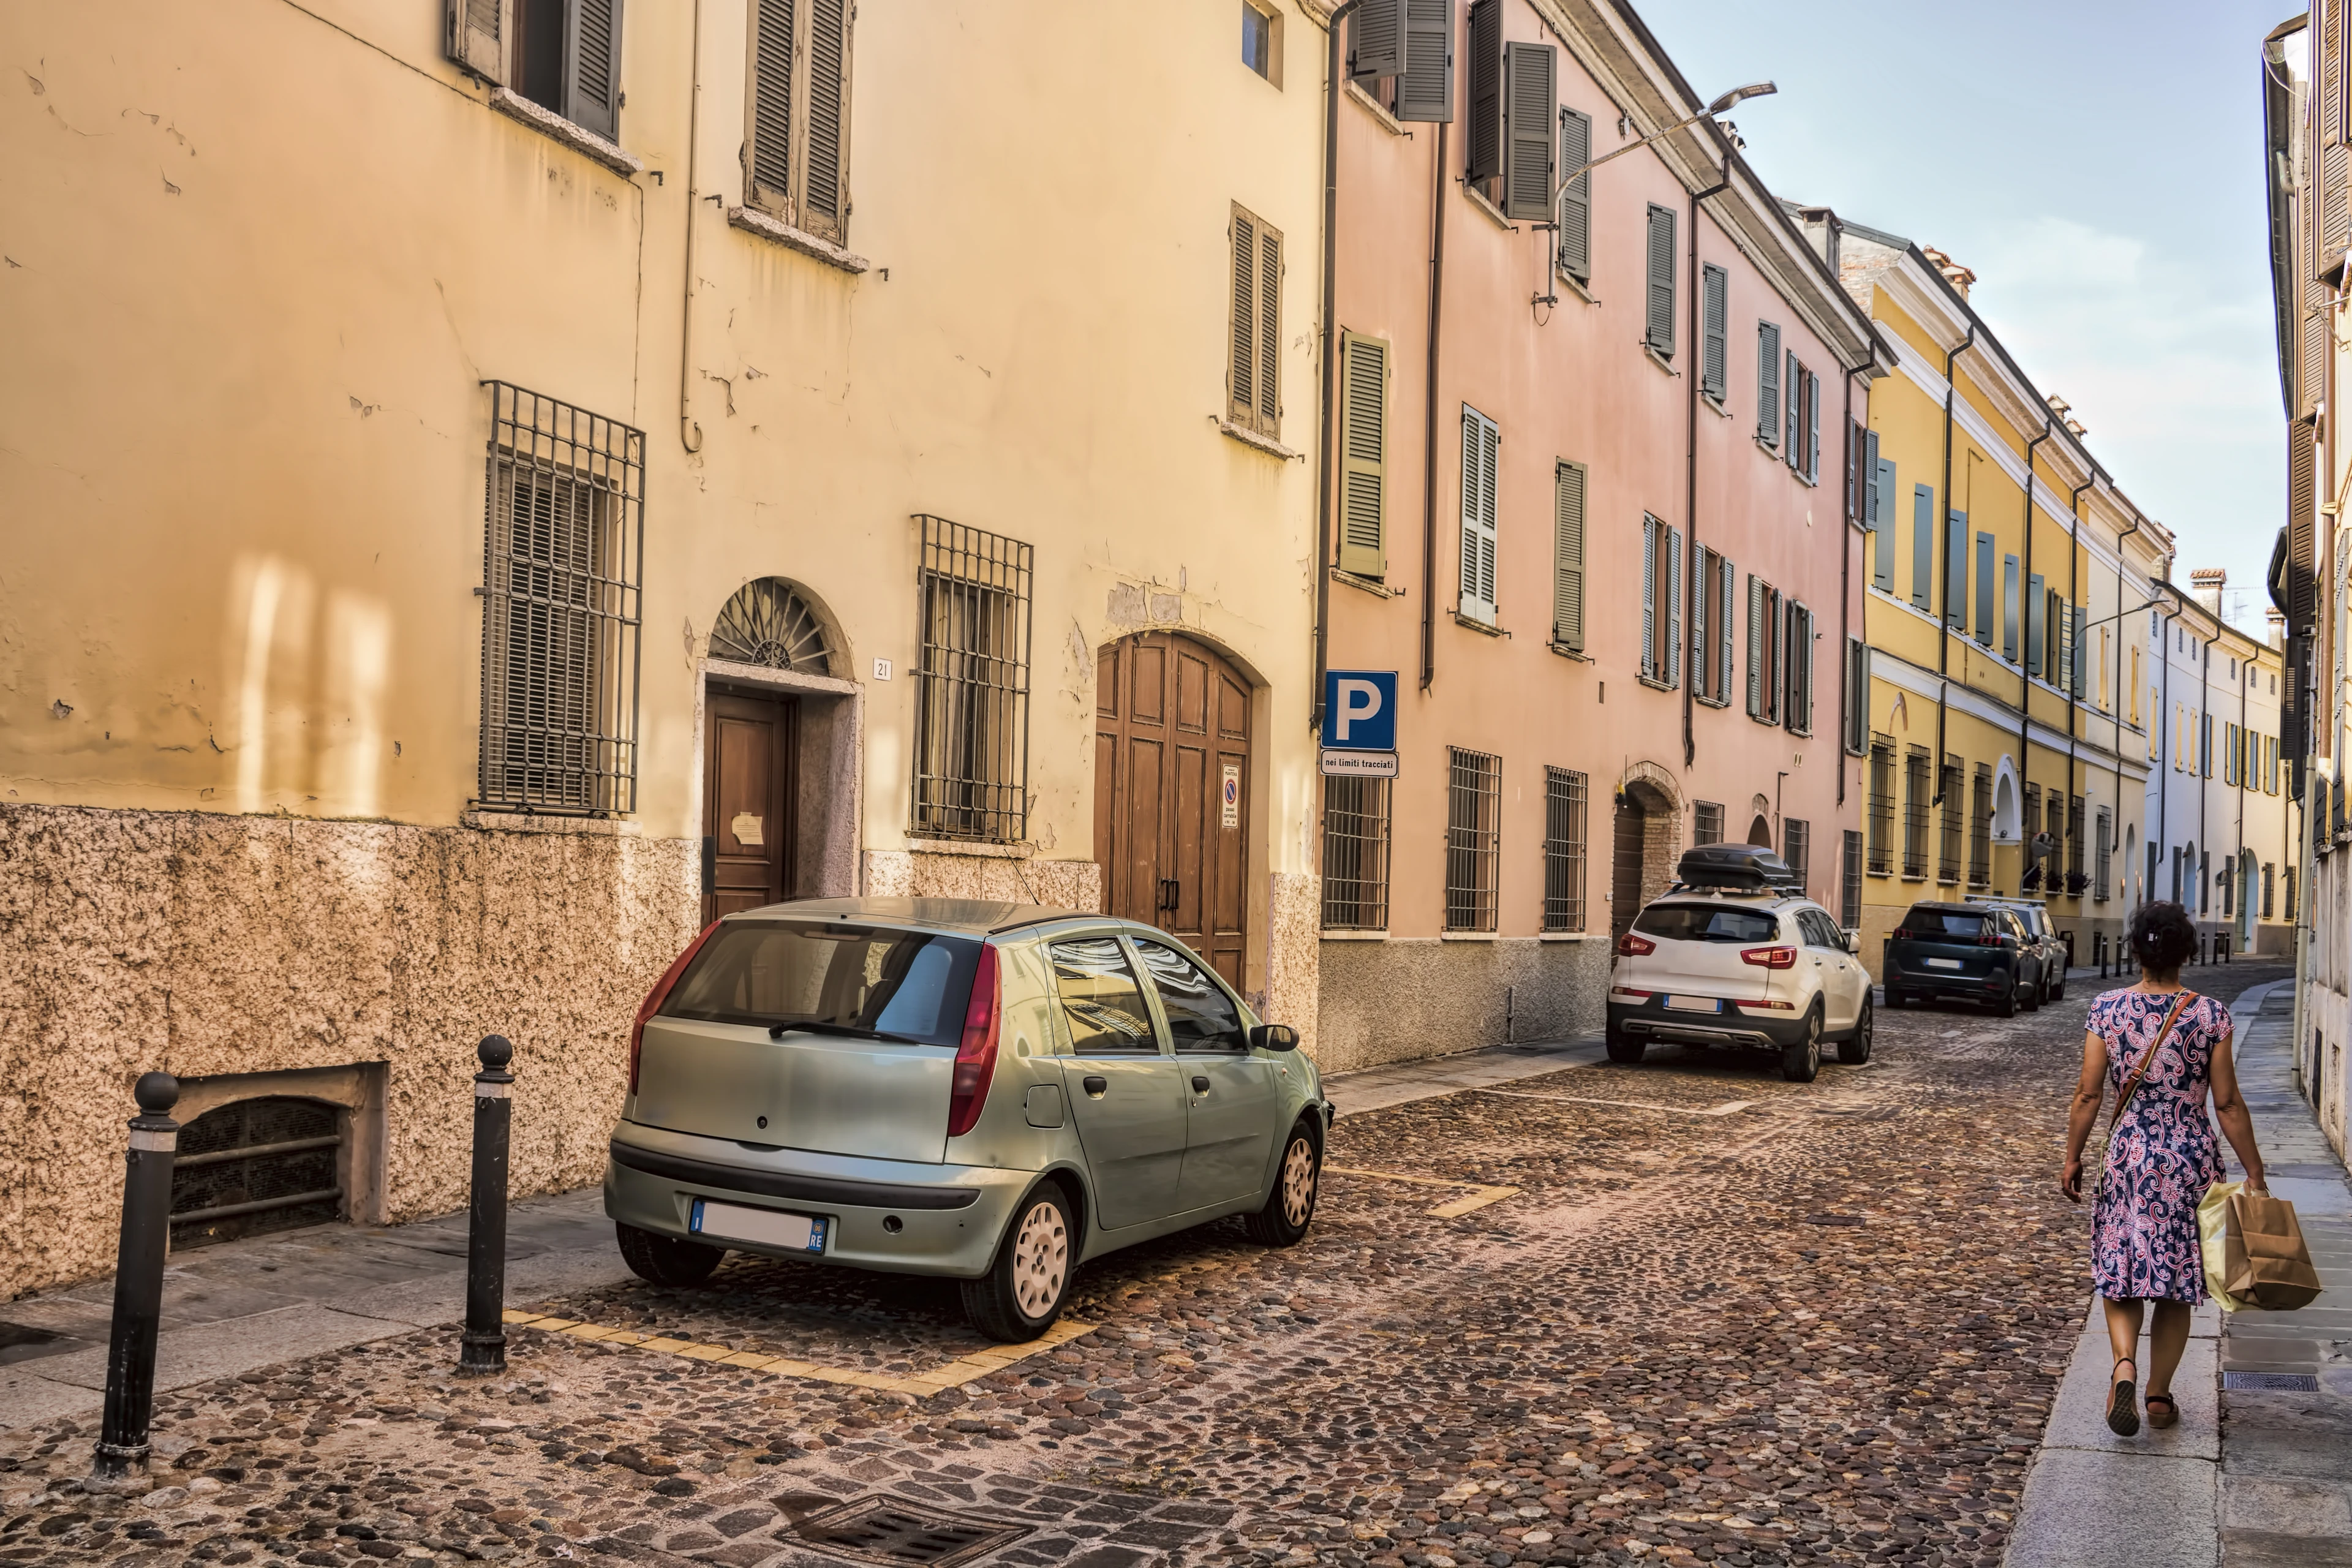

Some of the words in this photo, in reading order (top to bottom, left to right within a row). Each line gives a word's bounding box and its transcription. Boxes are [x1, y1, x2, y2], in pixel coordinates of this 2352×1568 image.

[878, 663, 887, 676] 21
[1336, 679, 1382, 741] P
[1339, 758, 1359, 767] limiti
[1362, 760, 1393, 769] tracciati
[810, 1234, 822, 1248] RE
